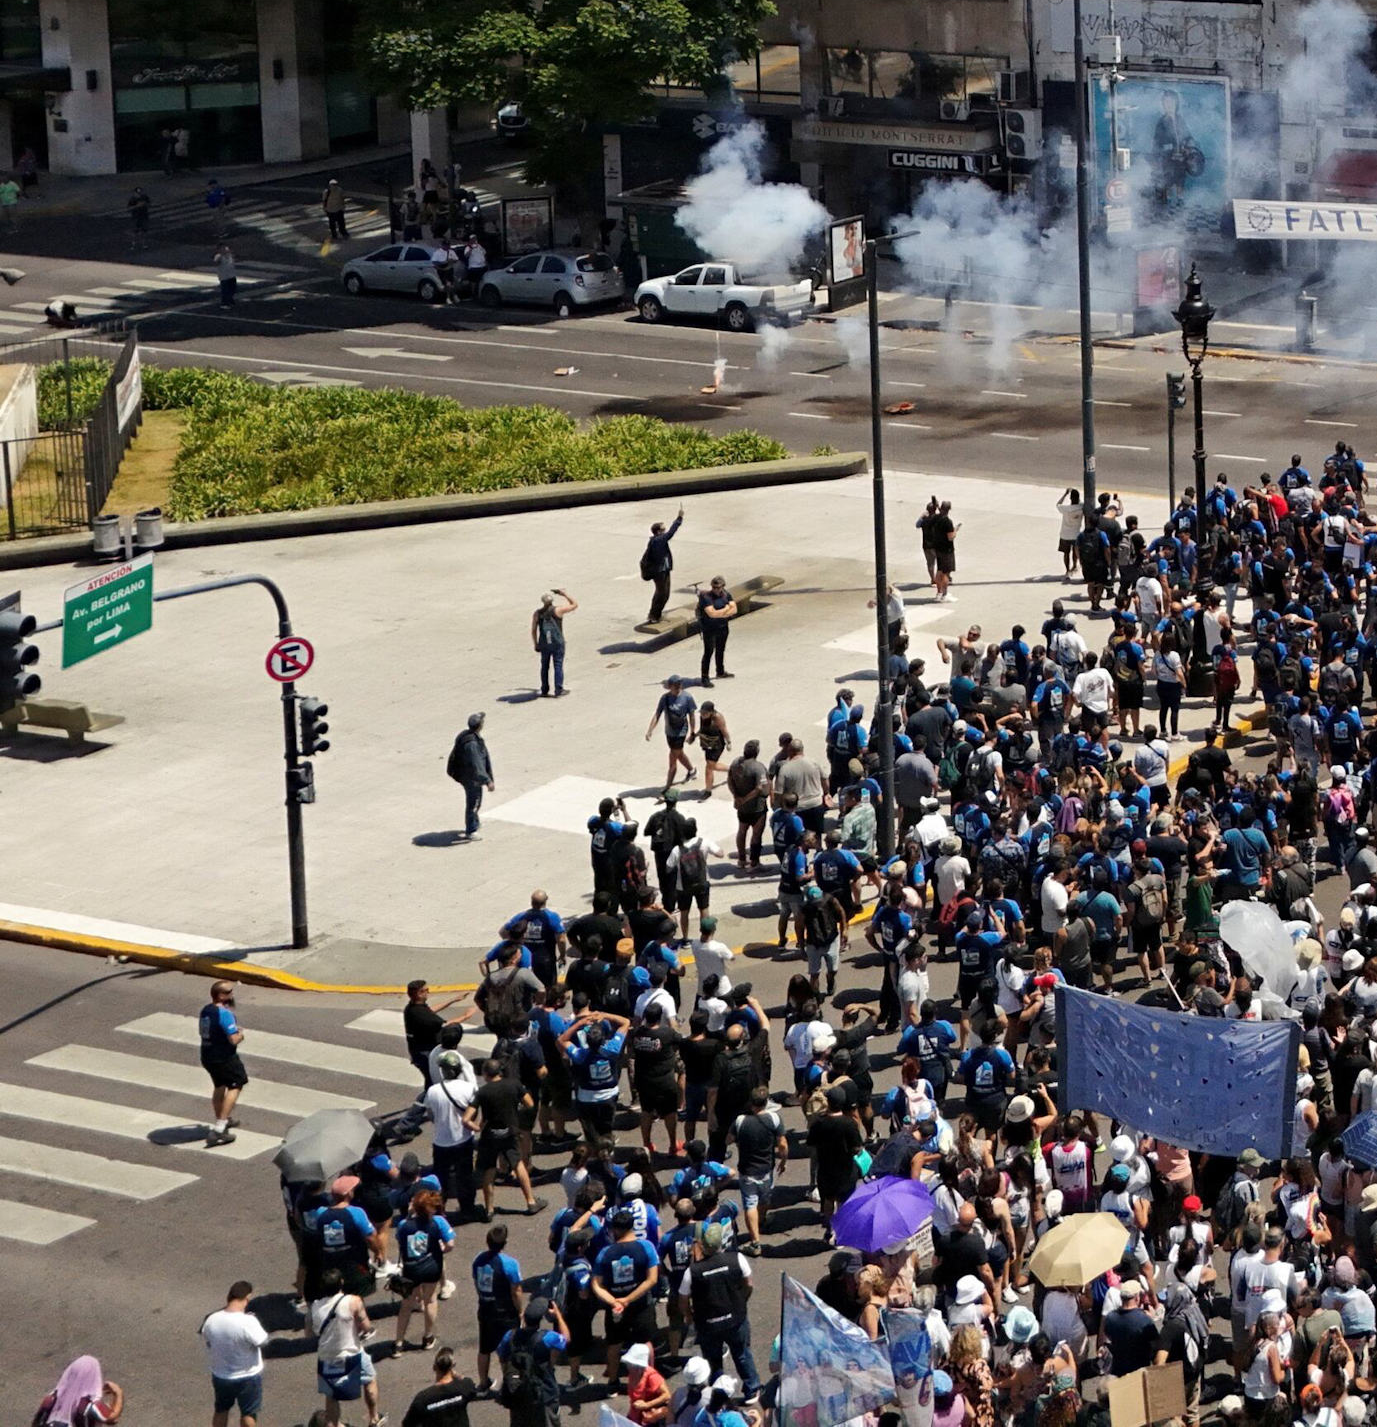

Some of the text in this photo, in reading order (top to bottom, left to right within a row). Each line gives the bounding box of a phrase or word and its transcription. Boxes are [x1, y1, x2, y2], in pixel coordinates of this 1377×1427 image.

[892, 152, 959, 171] CUGGINI
[71, 578, 146, 620] Av. BELGRANO
[86, 601, 132, 631] por LIMA
